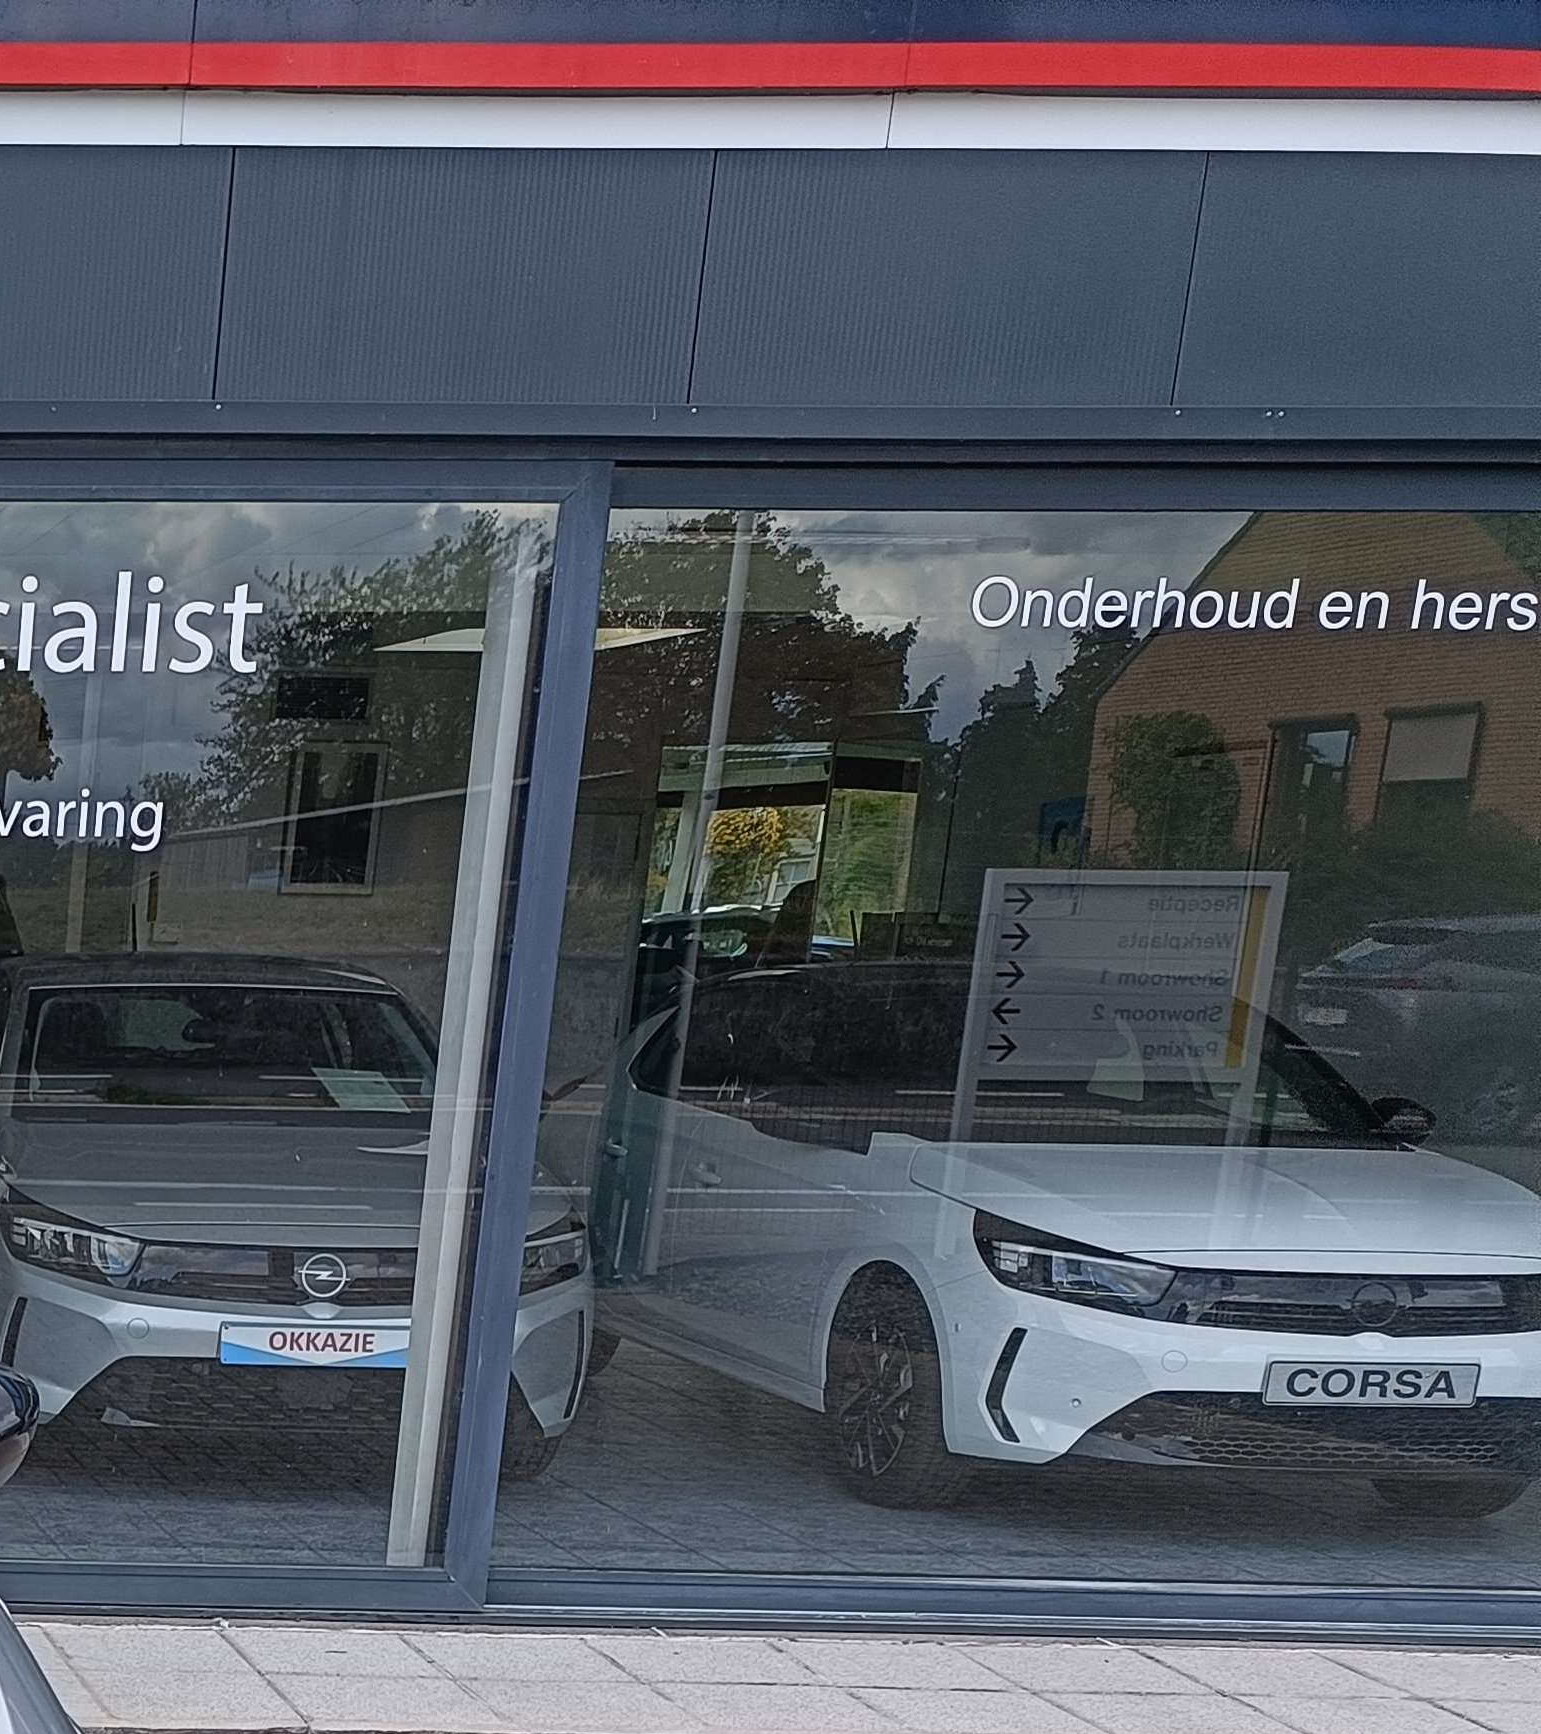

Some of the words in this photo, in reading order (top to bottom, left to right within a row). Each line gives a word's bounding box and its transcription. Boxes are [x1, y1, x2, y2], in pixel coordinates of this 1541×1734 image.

[972, 576, 1300, 630] Onderhoud
[1319, 591, 1389, 630] en
[1410, 579, 1538, 631] hers
[268, 1331, 375, 1353] OKKAZIE
[1286, 1368, 1456, 1399] CORSA
